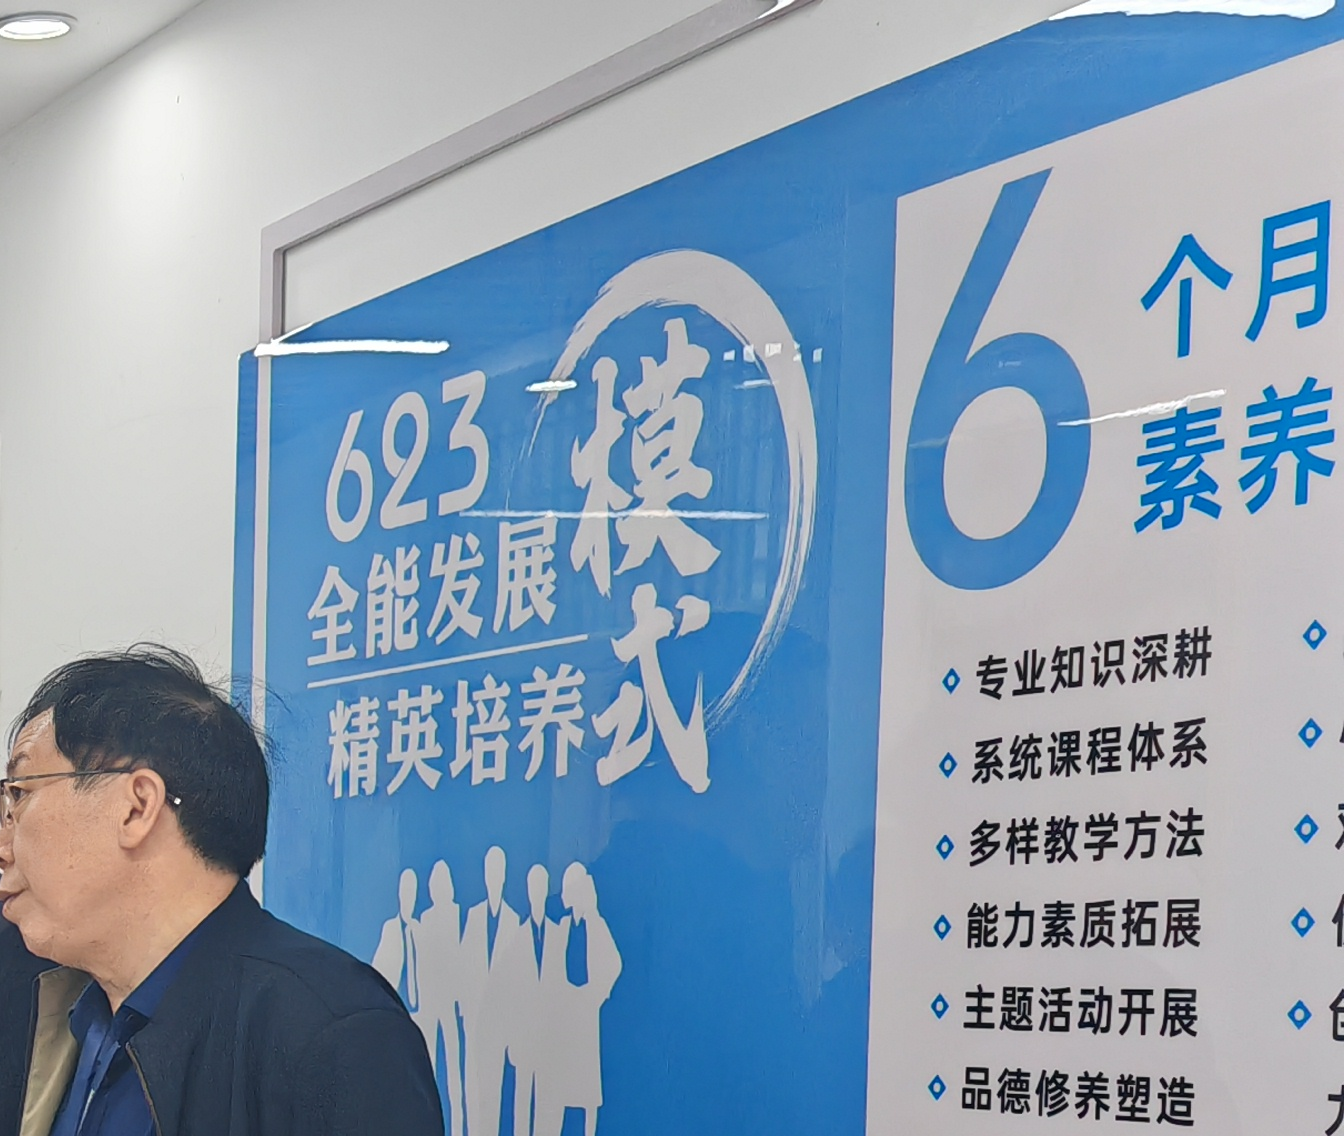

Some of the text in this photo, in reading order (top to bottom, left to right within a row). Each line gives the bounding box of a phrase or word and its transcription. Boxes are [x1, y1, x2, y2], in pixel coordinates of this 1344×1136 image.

[904, 166, 1331, 590] 6 个月
[325, 369, 490, 543] 623
[1134, 377, 1335, 533] 素养
[307, 513, 557, 666] 全能发展
[570, 317, 720, 793] 模式
[975, 626, 1212, 700] 专业知识深耕
[328, 664, 586, 799] 精英培养
[971, 717, 1208, 785] 系统课程体系
[969, 808, 1204, 867] 多样教学方法
[967, 898, 1202, 949] 能力素质拓展
[963, 985, 1198, 1037] 主题活动开展
[961, 1067, 1195, 1126] 品德修养塑造
